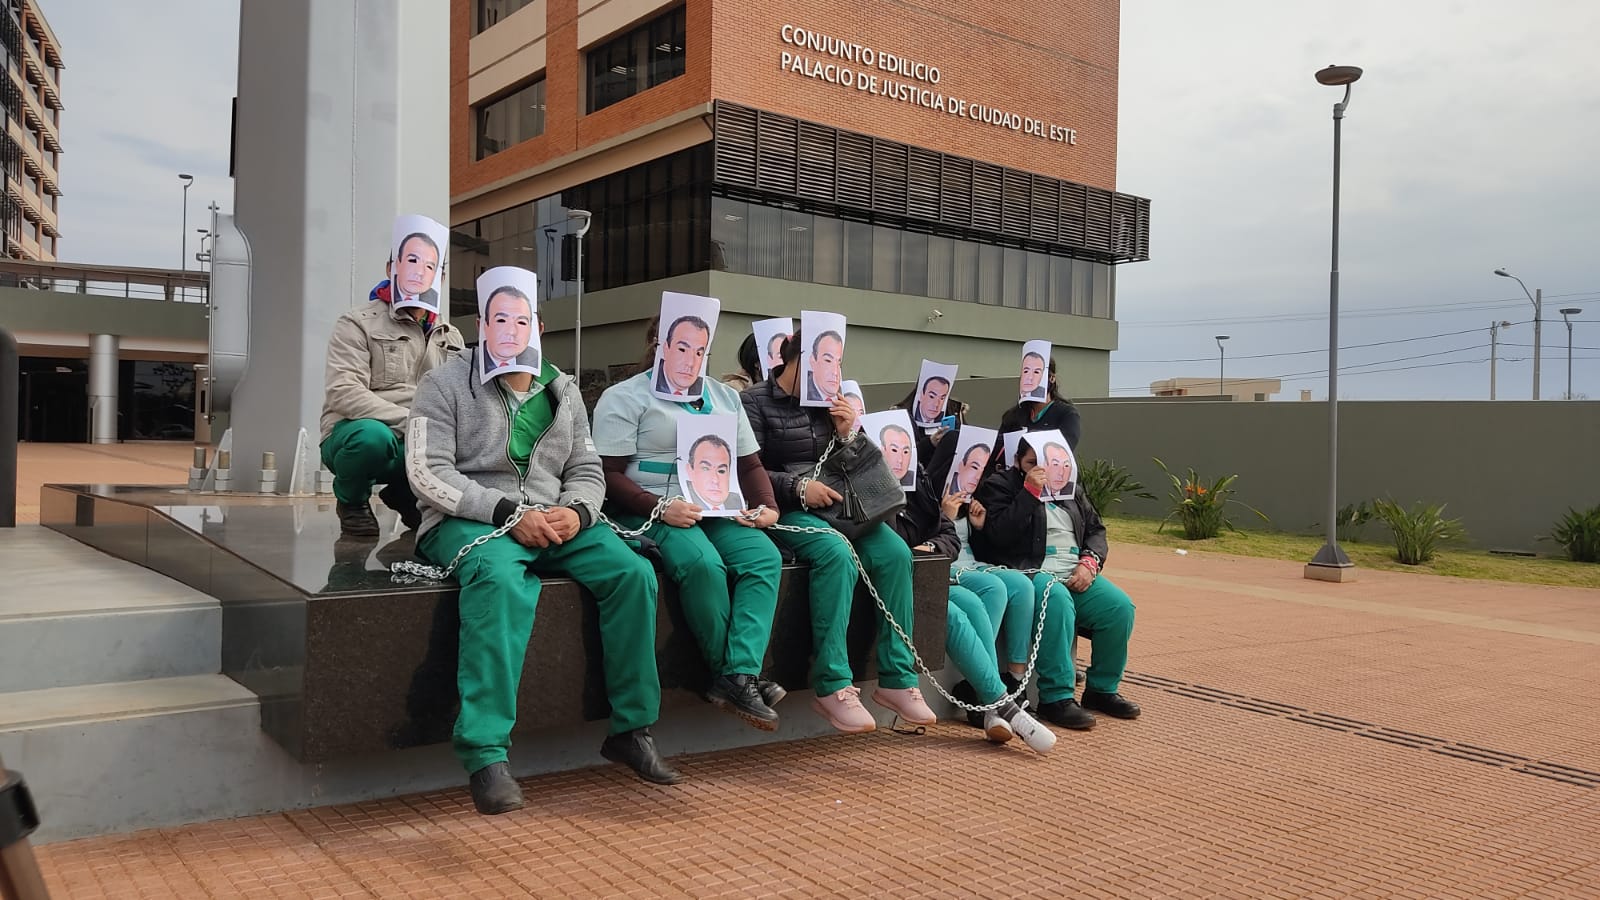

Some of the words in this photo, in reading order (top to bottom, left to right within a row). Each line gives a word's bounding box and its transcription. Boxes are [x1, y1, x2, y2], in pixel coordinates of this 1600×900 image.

[781, 24, 874, 65] CONJUNTO
[878, 51, 941, 84] EDILICIO
[781, 51, 853, 86] PALACIO
[857, 72, 877, 93] DE
[881, 79, 944, 111] JUSTICIA
[948, 97, 967, 117] DE
[969, 103, 1021, 130] CIUDAD
[1024, 117, 1047, 138] DEL
[1050, 124, 1077, 145] ESTE
